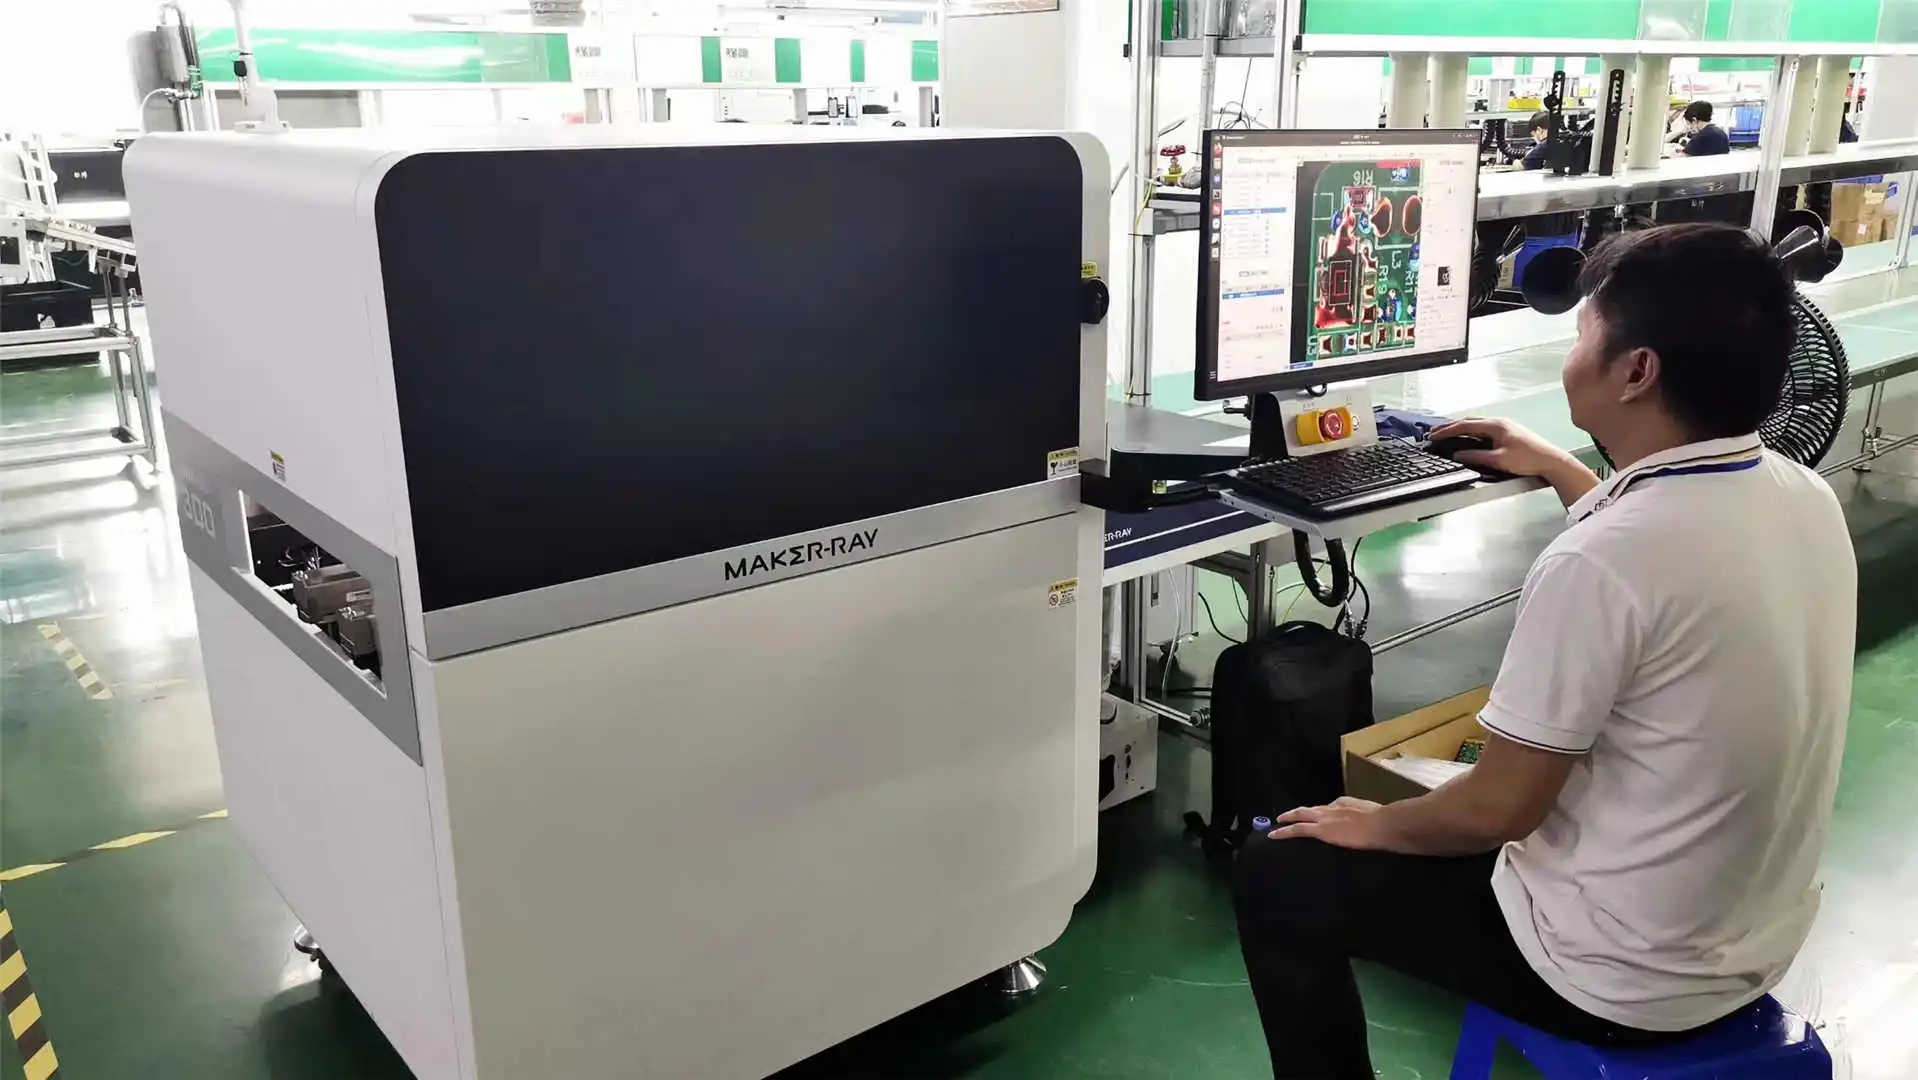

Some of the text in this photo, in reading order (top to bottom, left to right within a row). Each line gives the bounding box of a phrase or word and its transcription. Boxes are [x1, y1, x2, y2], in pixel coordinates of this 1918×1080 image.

[1352, 169, 1374, 187] R16
[1391, 250, 1402, 269] L3
[724, 528, 879, 580] MAKER-RAY
